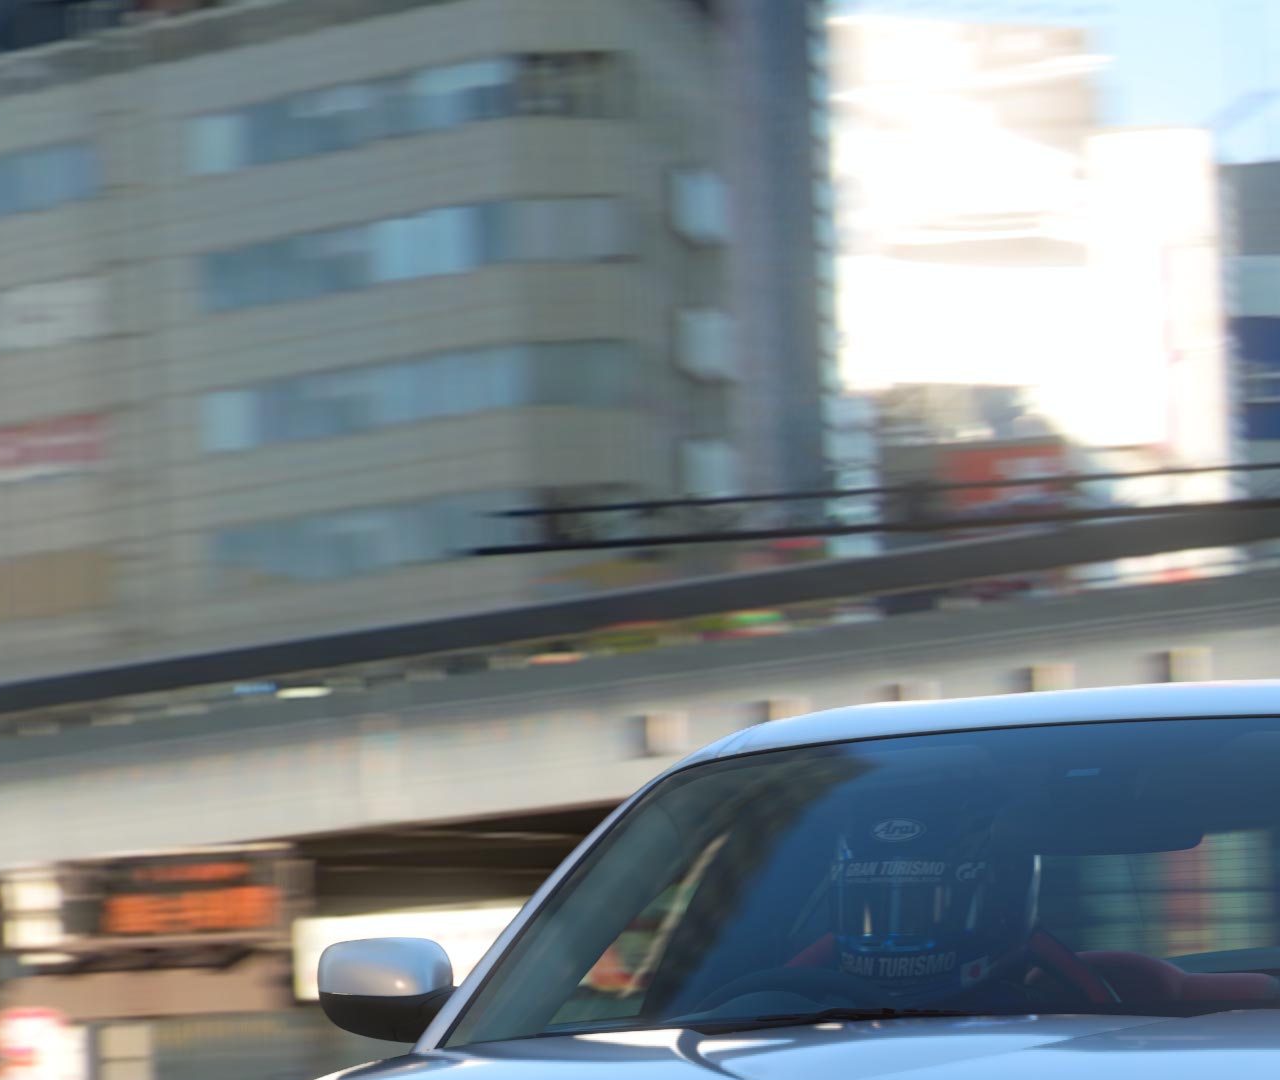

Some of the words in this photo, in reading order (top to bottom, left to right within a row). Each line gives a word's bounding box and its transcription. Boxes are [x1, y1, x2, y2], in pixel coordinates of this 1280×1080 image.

[845, 861, 879, 876] GRAN
[880, 860, 946, 876] TURISMO
[840, 952, 875, 977] GRAN
[878, 951, 957, 977] TURISMO
